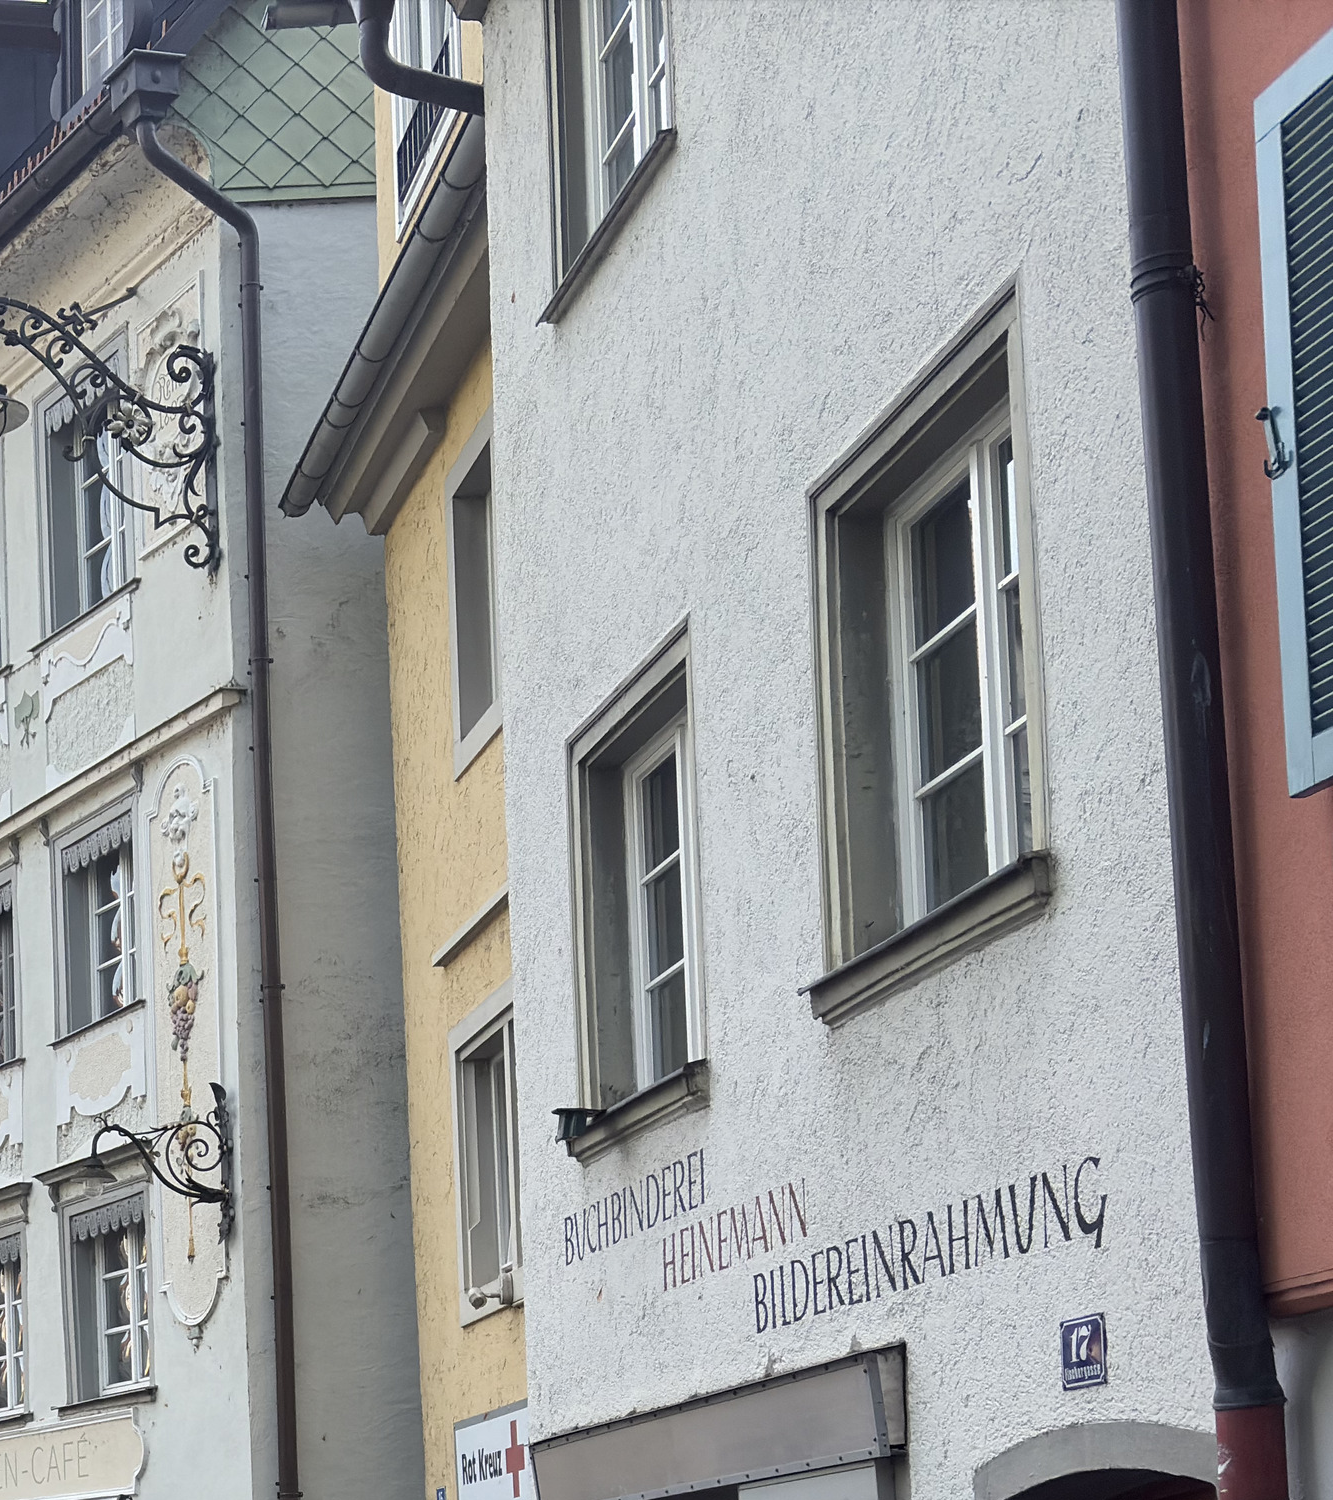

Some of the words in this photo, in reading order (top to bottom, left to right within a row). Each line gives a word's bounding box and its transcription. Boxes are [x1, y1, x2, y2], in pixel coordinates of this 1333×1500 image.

[564, 1148, 706, 1266] BUCHBINDEREI
[662, 1177, 808, 1291] HEINEMANN
[753, 1156, 1108, 1334] BILDEREINRAHMUNG
[1070, 1325, 1091, 1363] 17
[461, 1450, 477, 1486] Rot
[478, 1448, 503, 1482] Kreuz
